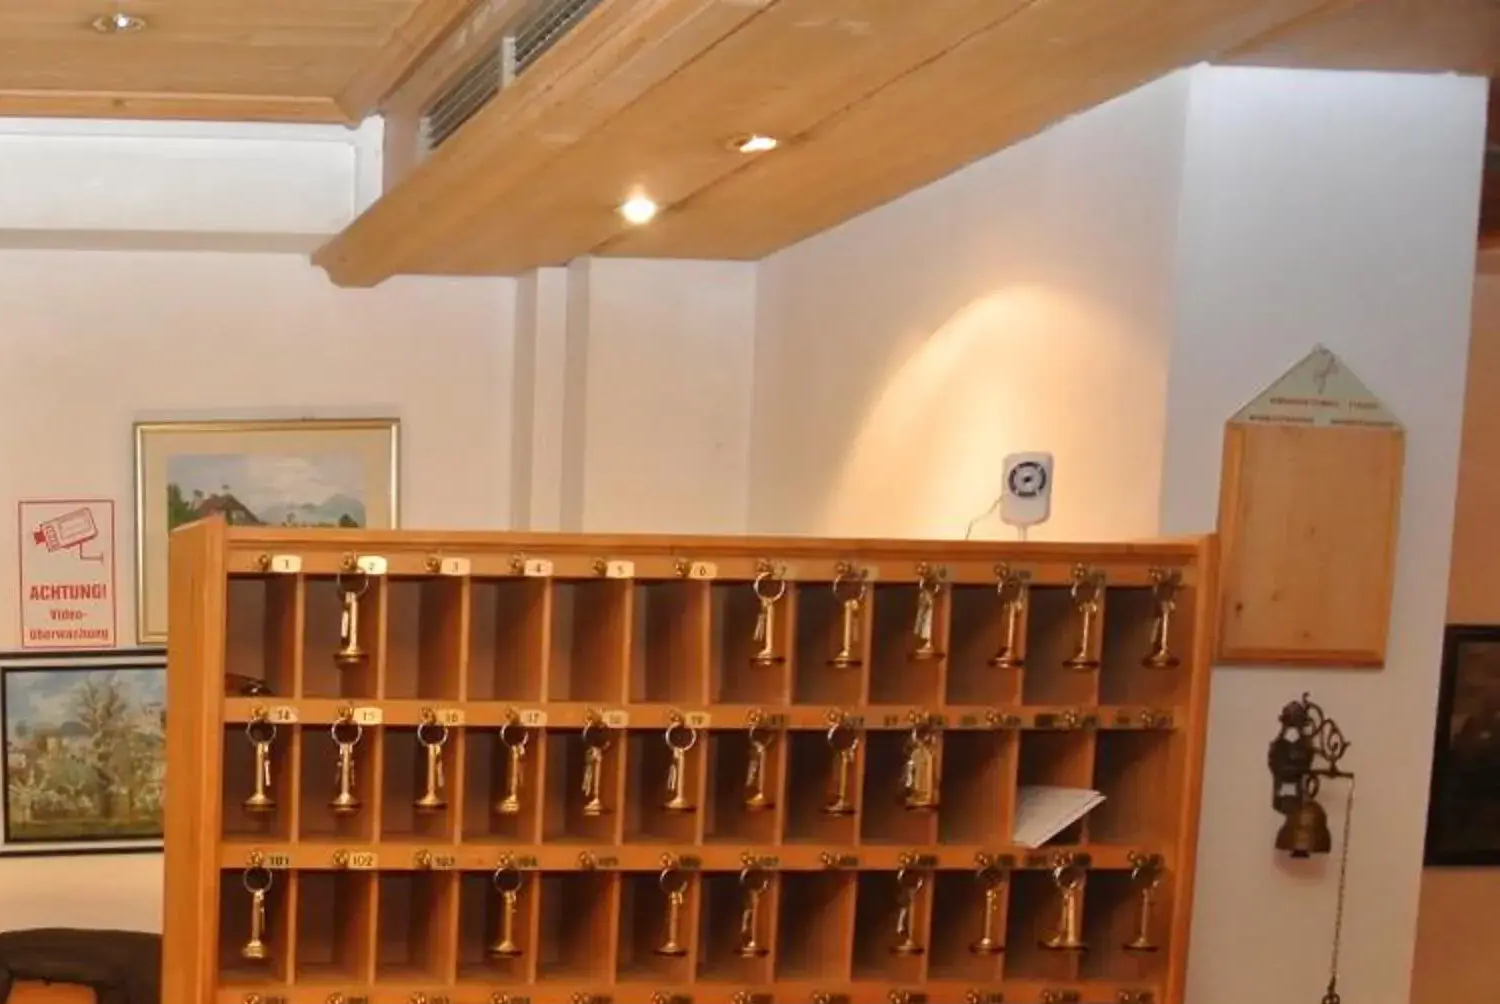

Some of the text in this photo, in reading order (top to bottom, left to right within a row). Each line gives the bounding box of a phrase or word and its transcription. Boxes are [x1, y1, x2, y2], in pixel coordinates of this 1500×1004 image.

[29, 584, 107, 600] ACHTUNG!
[50, 609, 88, 621] Video-
[352, 856, 374, 866] 102
